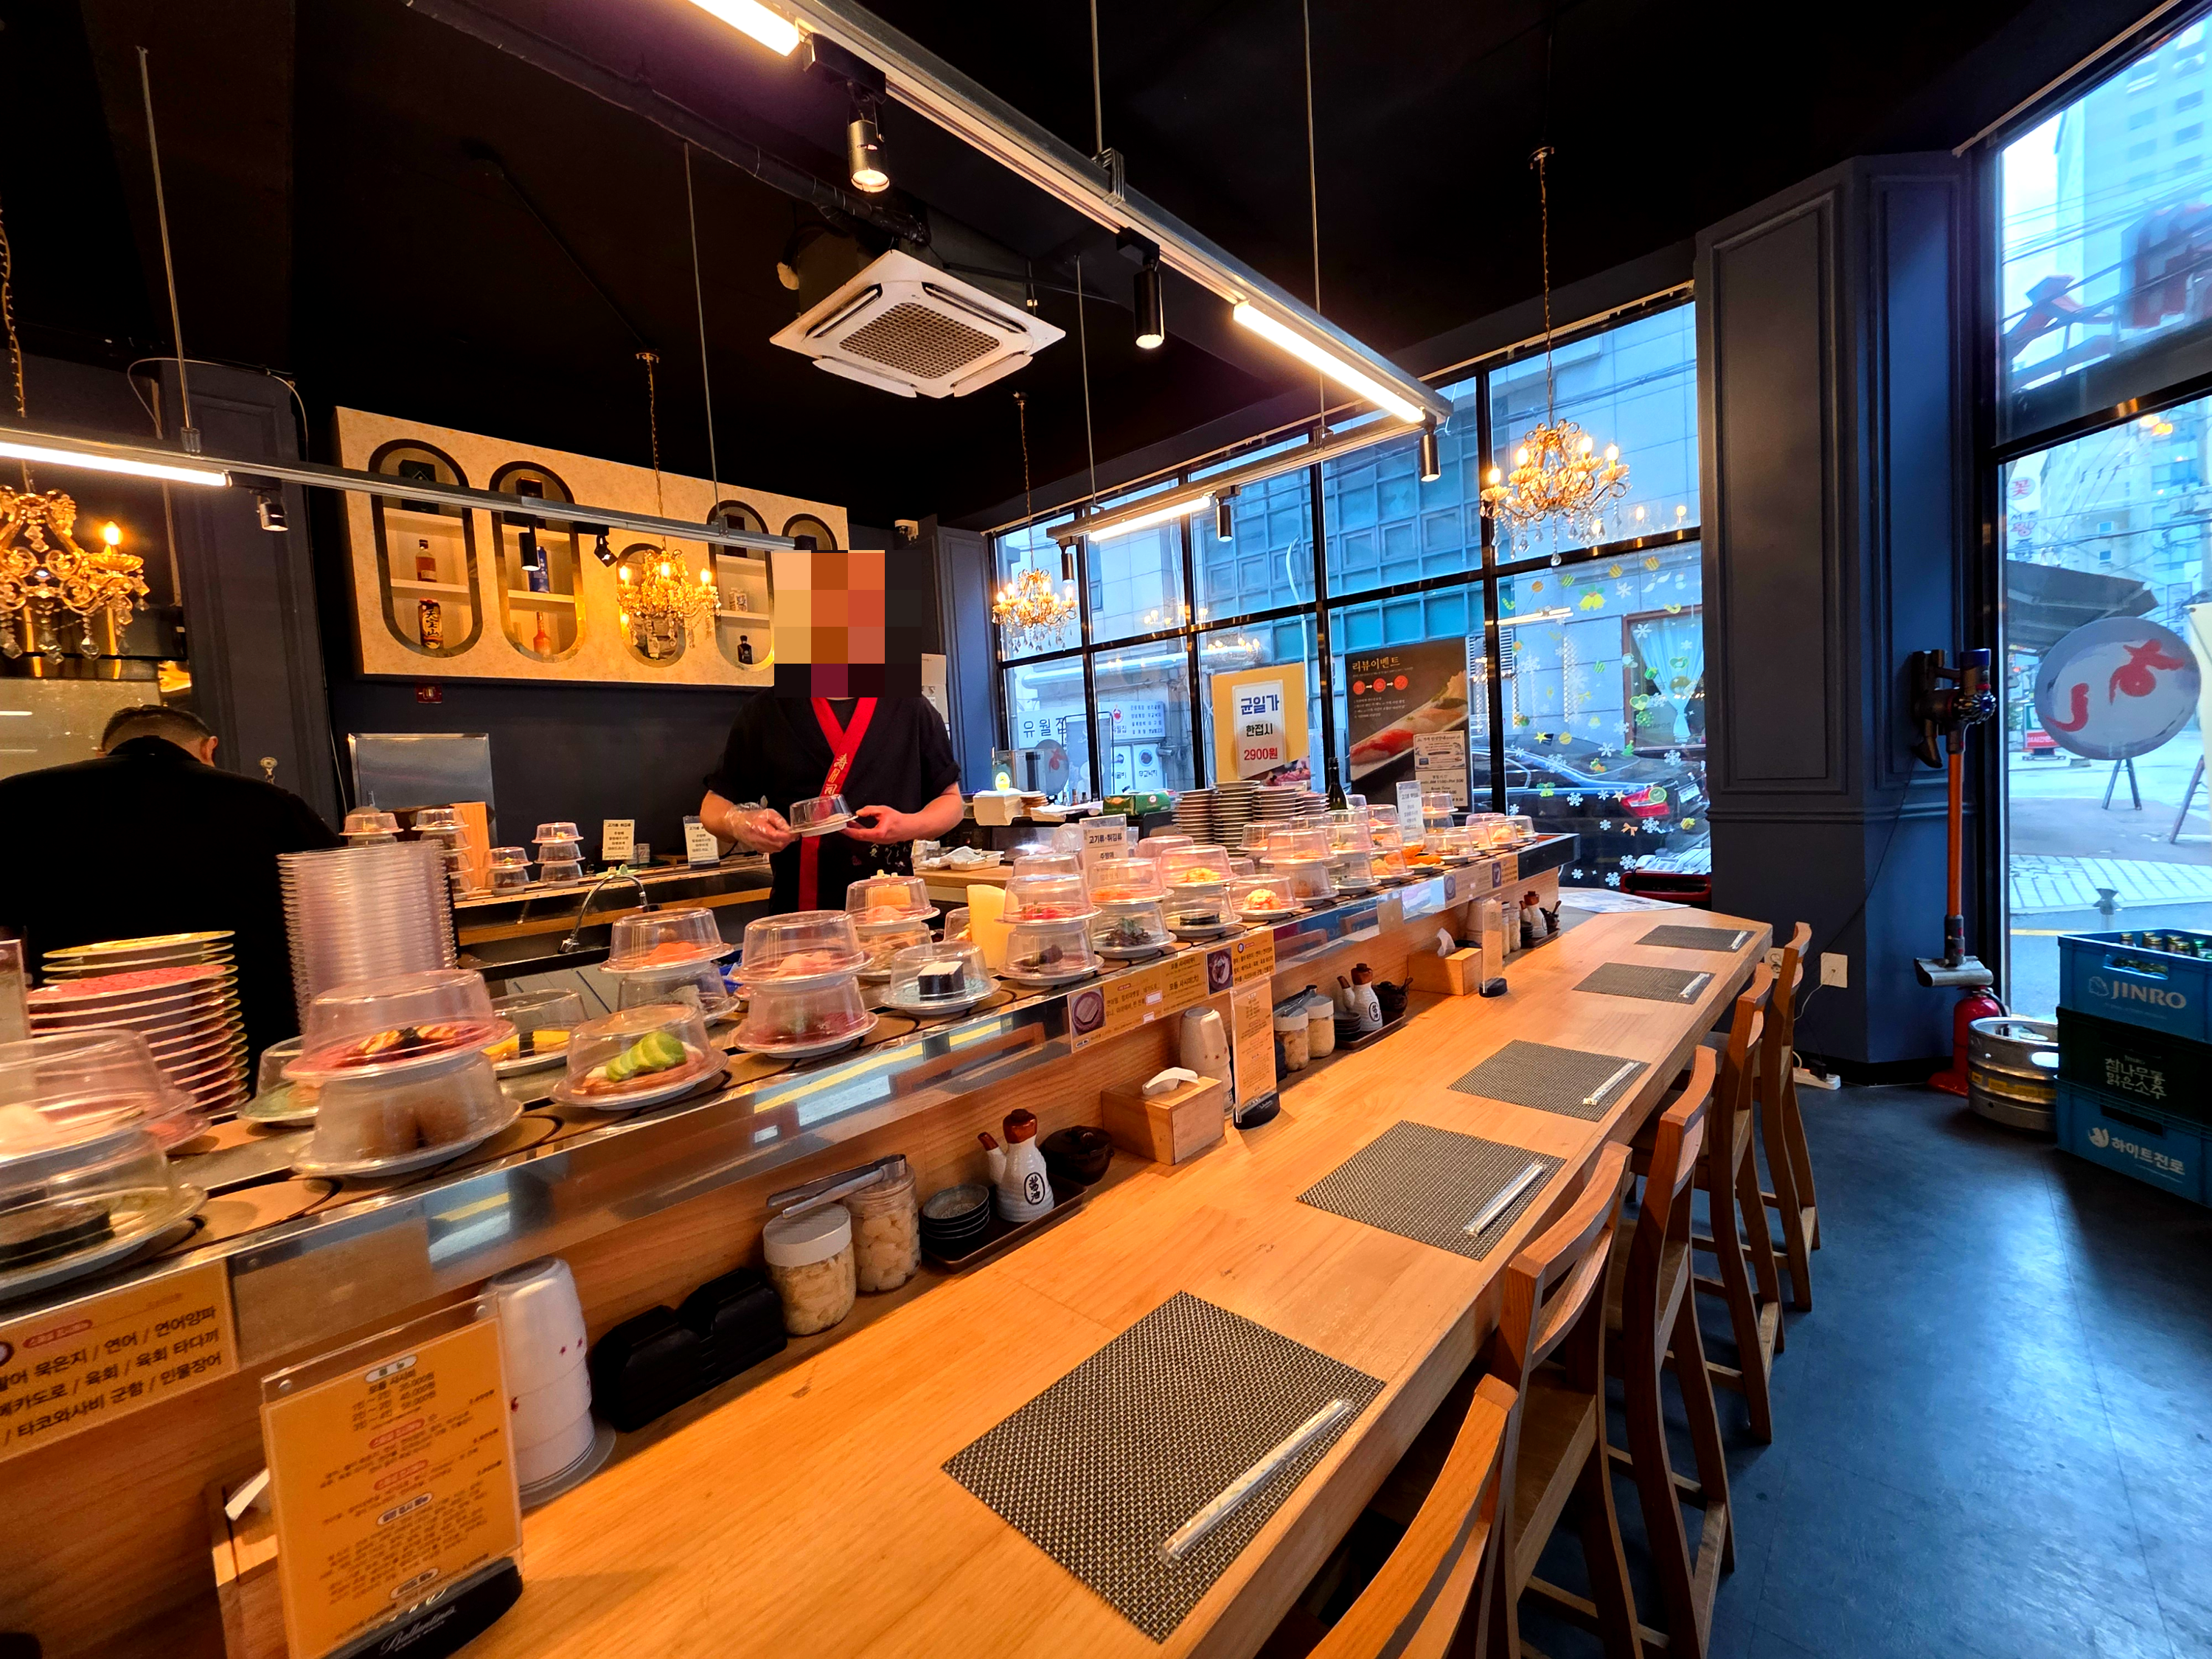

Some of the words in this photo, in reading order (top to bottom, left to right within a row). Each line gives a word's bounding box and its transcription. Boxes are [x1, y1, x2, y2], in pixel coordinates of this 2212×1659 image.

[1352, 656, 1400, 672] 리뷰이벤트
[1240, 694, 1279, 715] 균일가
[1246, 723, 1273, 737] 한접시
[1244, 748, 1278, 761] 2900원
[2111, 981, 2187, 1009] JINRO
[2104, 1057, 2166, 1085] 참나무통
[2105, 1071, 2168, 1099] 맑은소주
[2112, 1137, 2186, 1175] 하이트진로
[34, 1349, 88, 1377] 묵은지
[105, 1332, 139, 1355] 연어
[155, 1306, 217, 1338] 연어양파
[86, 1364, 119, 1385] 육회
[136, 1346, 168, 1368] 육회
[18, 1394, 105, 1437] 타코와사비
[111, 1380, 145, 1404] 군함
[161, 1351, 222, 1386] 민물장어
